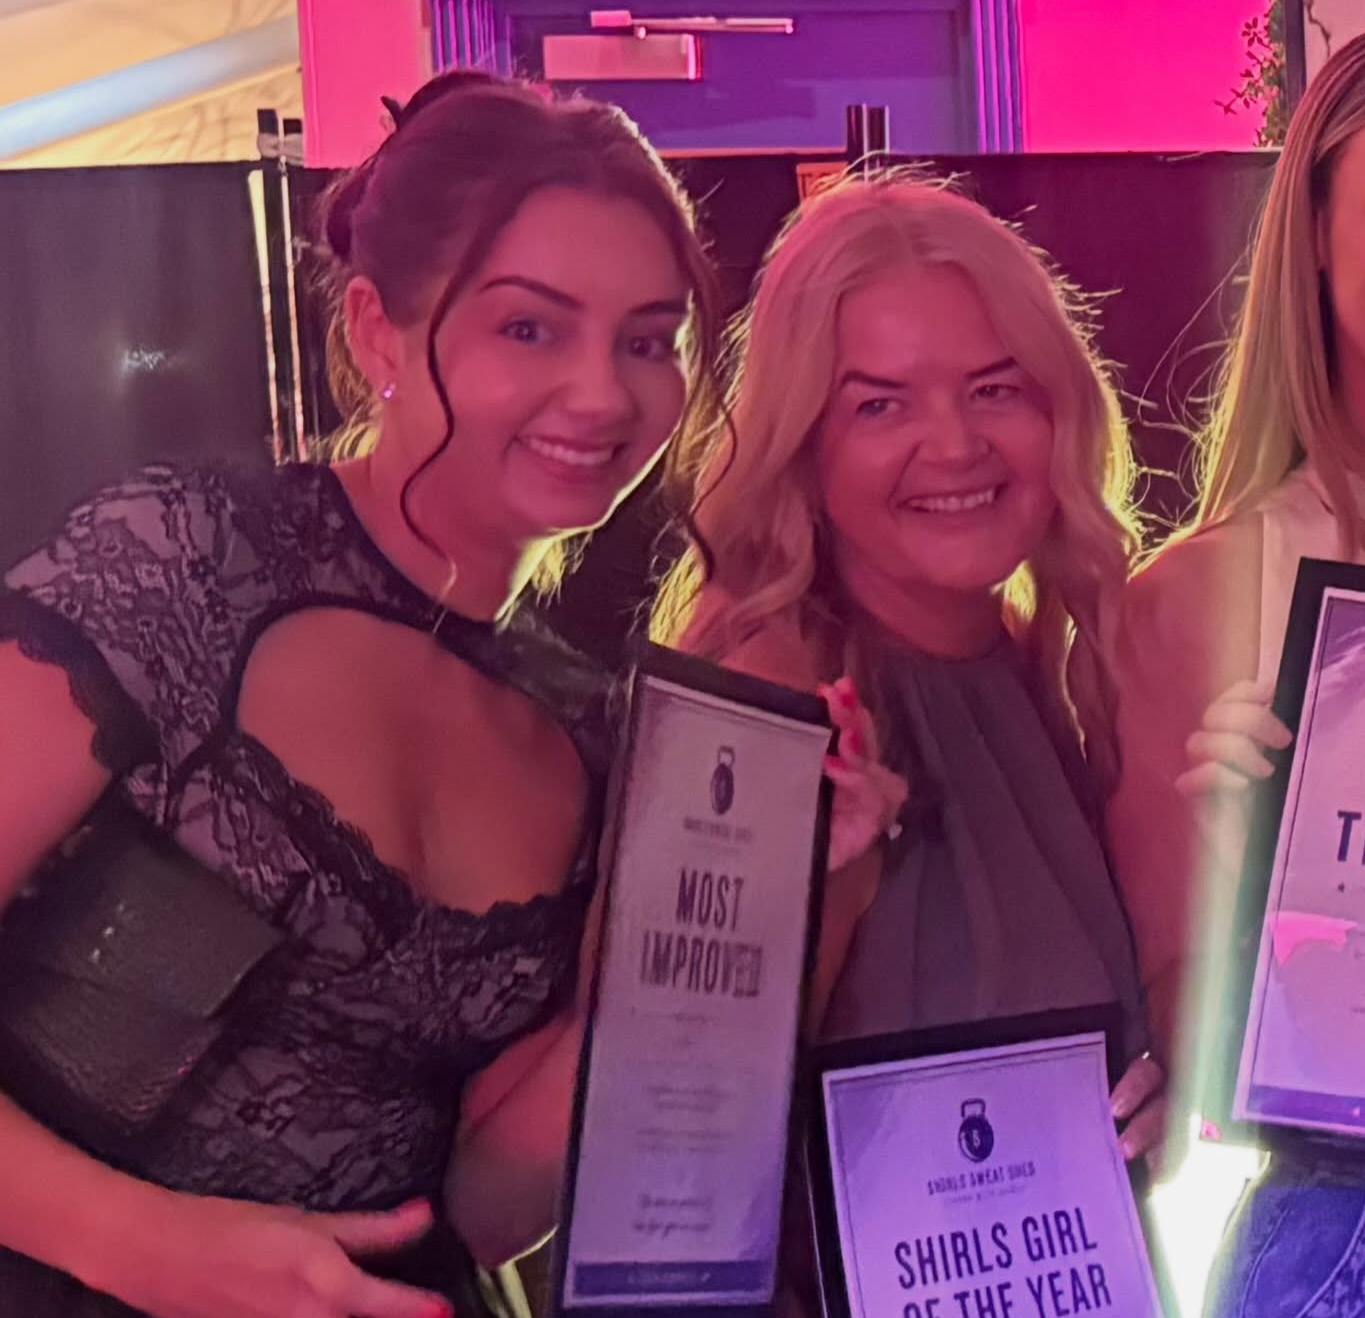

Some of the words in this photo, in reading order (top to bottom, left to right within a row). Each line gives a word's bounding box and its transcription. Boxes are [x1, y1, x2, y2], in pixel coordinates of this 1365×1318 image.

[675, 866, 745, 932] MOST
[639, 930, 763, 999] IMPROVED
[894, 1221, 1014, 1290] SHIRLS
[1020, 1206, 1099, 1263] GIRL
